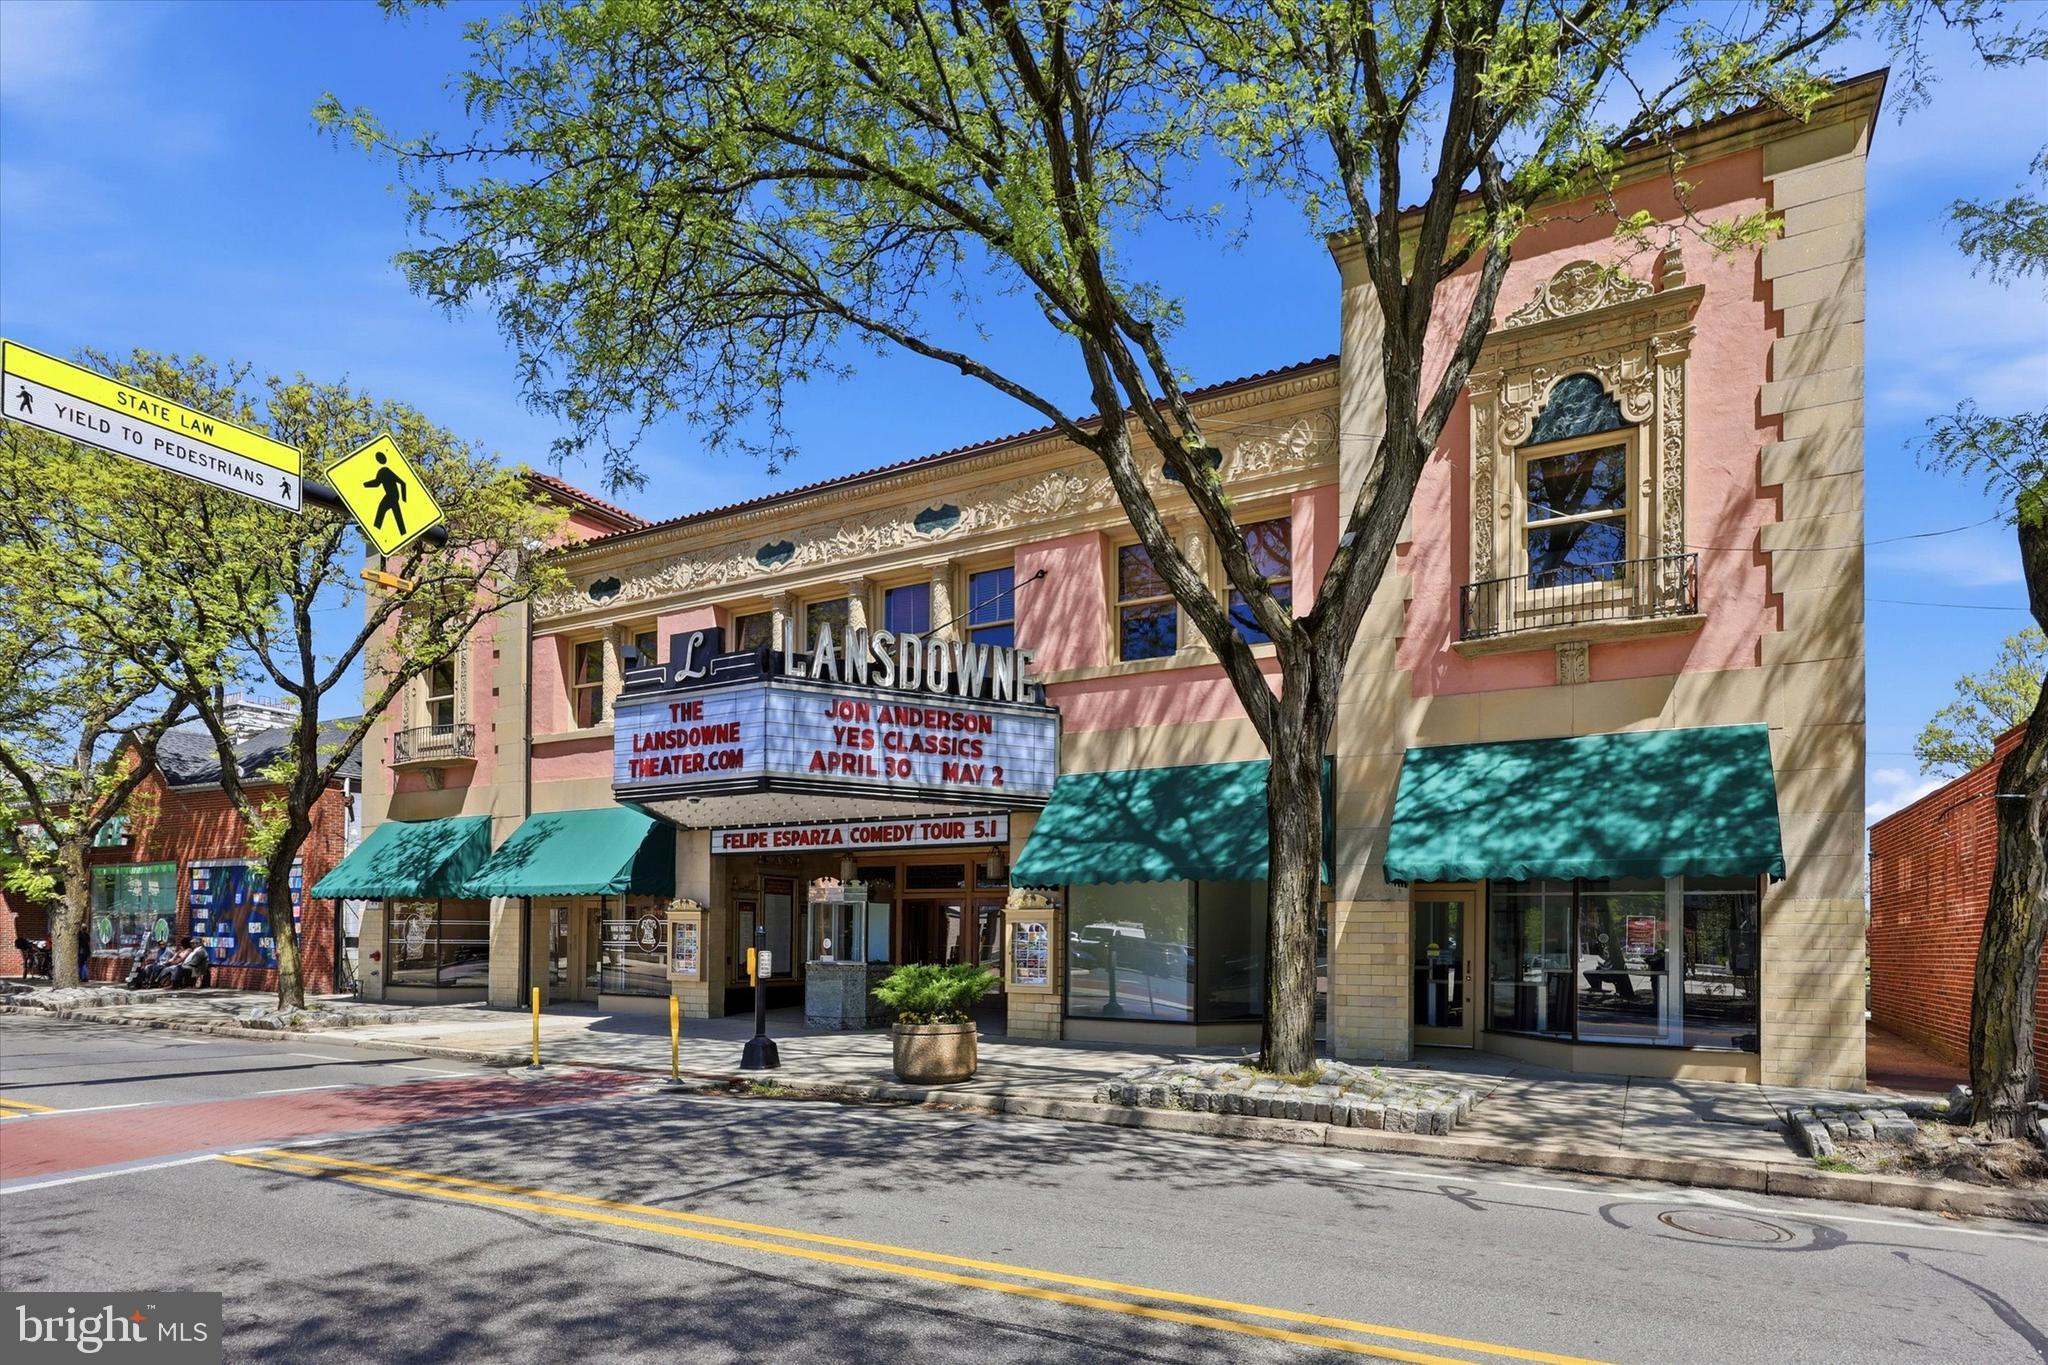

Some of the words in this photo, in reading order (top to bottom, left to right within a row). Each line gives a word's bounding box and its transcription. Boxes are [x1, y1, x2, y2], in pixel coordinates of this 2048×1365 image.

[117, 390, 170, 422] STATE
[181, 414, 215, 437] LAW
[54, 402, 111, 434] YIELD
[122, 426, 143, 445] TO
[154, 438, 265, 487] PEDESTRIANS
[674, 631, 707, 682] L
[784, 617, 1036, 703] LANSDOWNE
[669, 700, 704, 723] THE
[824, 699, 870, 724] JON
[877, 704, 993, 735] ANDERSON
[633, 721, 741, 753] LANSDOWNE
[833, 725, 875, 750] YES
[883, 731, 984, 759] CLASSICS
[629, 748, 744, 778] THEATER.COM
[809, 750, 878, 777] APRIL
[884, 756, 912, 779] 30
[942, 762, 985, 785] MAY
[991, 765, 1004, 787] 2
[723, 831, 768, 849] FELIPE
[773, 828, 843, 848] ESPARZA
[850, 824, 915, 843] COMEDY
[921, 821, 965, 840] TOUR
